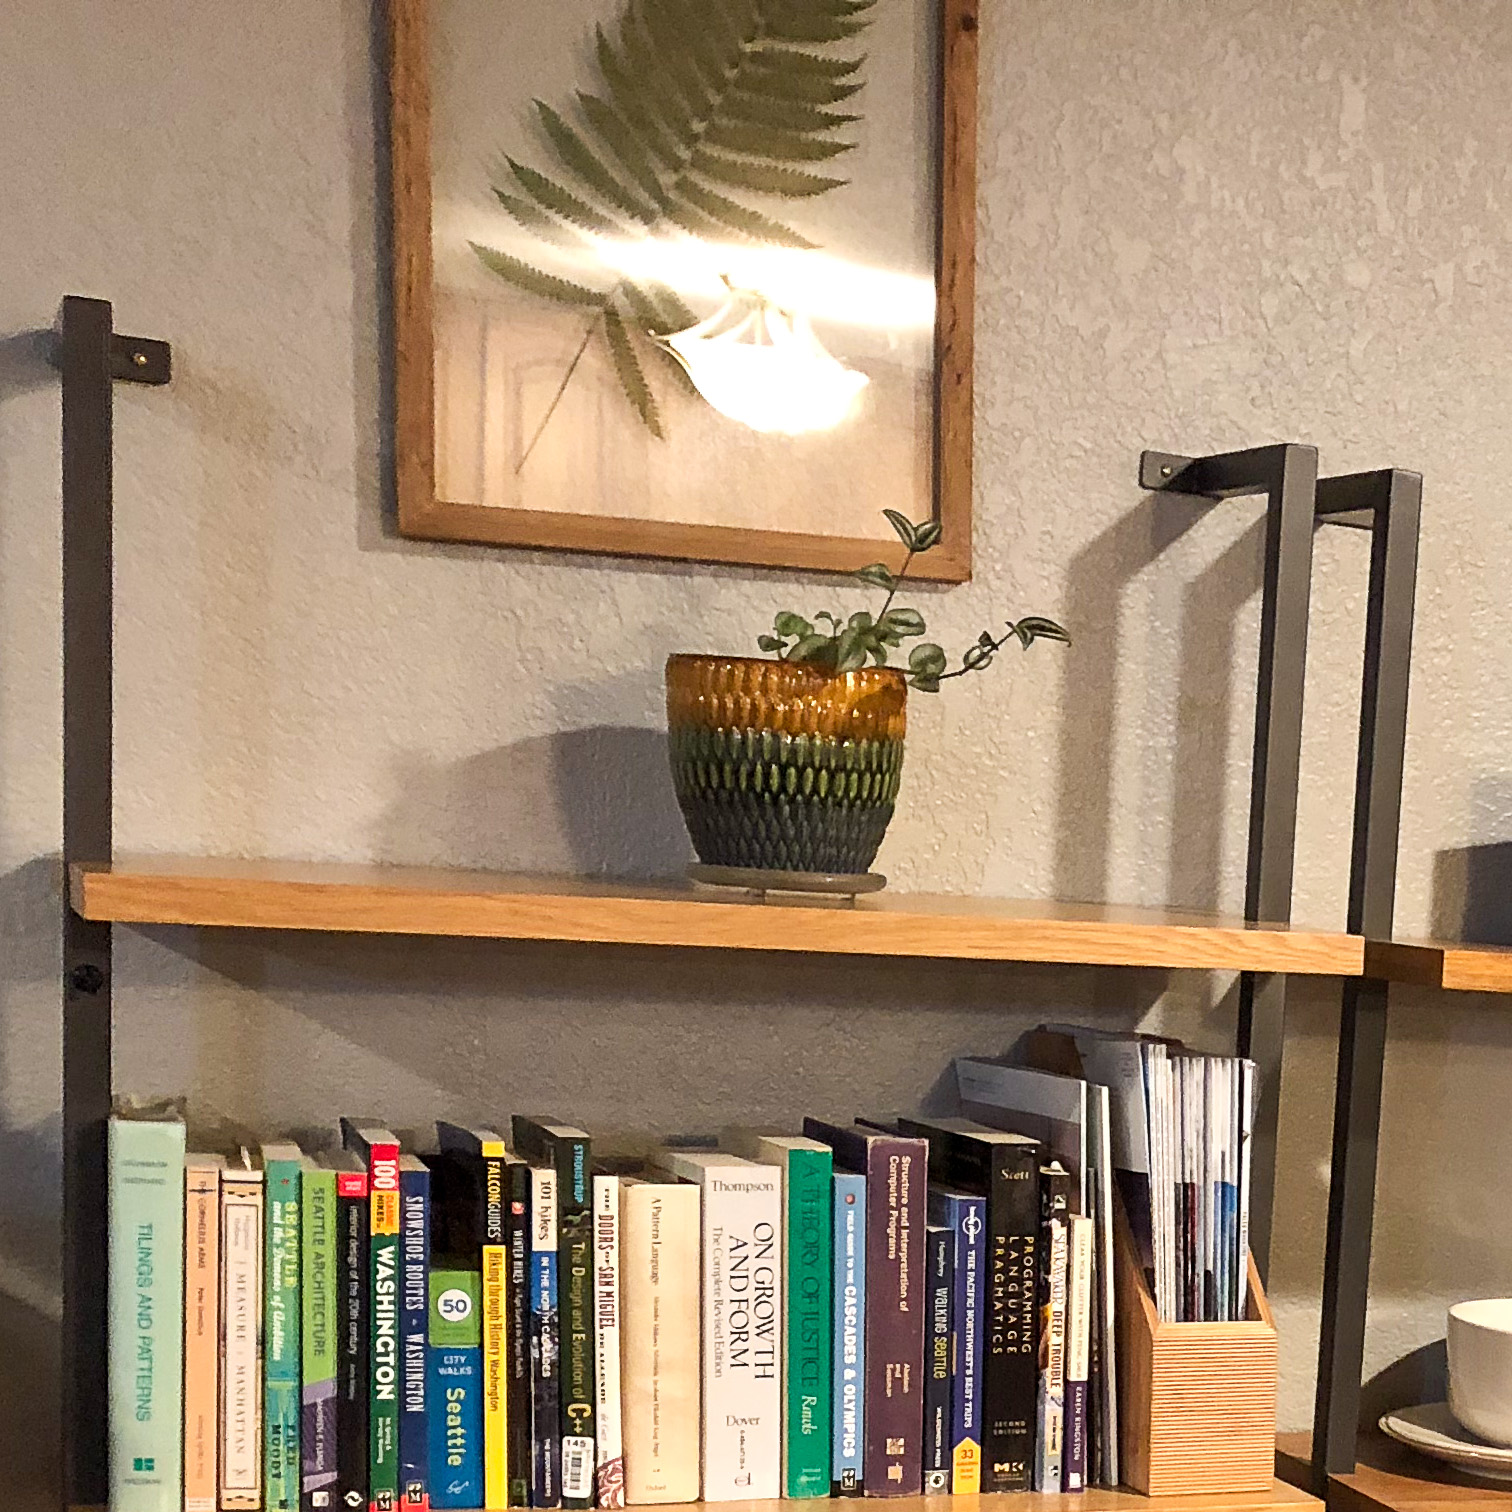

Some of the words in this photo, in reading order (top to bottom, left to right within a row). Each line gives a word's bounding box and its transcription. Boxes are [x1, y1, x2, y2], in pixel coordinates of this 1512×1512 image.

[374, 1159, 395, 1188] 100
[573, 1144, 583, 1203] STROUSTRUP
[712, 1181, 774, 1191] Thompson
[801, 1166, 819, 1178] A
[887, 1155, 898, 1206] Computer
[899, 1155, 910, 1204] Structure
[1001, 1170, 1028, 1179] Scott
[487, 1161, 501, 1238] FALCONGUIDES
[540, 1180, 552, 1200] 101
[272, 1201, 283, 1227] and
[312, 1187, 325, 1246] SEATTLE
[375, 1195, 384, 1221] HIKES
[539, 1206, 552, 1240] hikes
[652, 1206, 661, 1239] Pattern
[900, 1207, 909, 1227] and
[272, 1229, 283, 1246] the
[284, 1201, 297, 1287] SEATTLE
[405, 1196, 424, 1260] SNOWSHOE
[512, 1230, 524, 1258] WINTER
[598, 1214, 615, 1251] DOORS
[713, 1226, 723, 1246] The
[754, 1222, 774, 1260] ON
[800, 1185, 819, 1268] THEORY
[887, 1210, 898, 1259] Programs
[137, 1224, 153, 1288] TILINGS
[348, 1239, 358, 1268] design
[488, 1252, 501, 1281] Hiking
[540, 1257, 549, 1266] IN
[572, 1242, 586, 1263] The
[650, 1241, 661, 1286] Language
[729, 1235, 749, 1293] AND
[847, 1257, 854, 1268] TO
[898, 1229, 910, 1298] Interpretation
[936, 1240, 946, 1277] Humphrey
[966, 1250, 975, 1269] THE
[349, 1270, 359, 1280] of
[349, 1282, 359, 1296] the
[406, 1265, 424, 1310] ROUTES
[512, 1261, 523, 1284] HIKES
[540, 1269, 549, 1287] THE
[571, 1267, 585, 1306] Design
[599, 1266, 615, 1287] SAN
[711, 1248, 723, 1297] Complete
[846, 1269, 854, 1284] THE
[965, 1271, 975, 1307] PACIFIC
[236, 1273, 246, 1342] MEASURE
[270, 1295, 283, 1308] of
[311, 1252, 325, 1357] ARCHITECTURE
[349, 1299, 359, 1319] 20th
[443, 1298, 467, 1313] 50
[487, 1283, 501, 1320] through
[599, 1290, 615, 1328] MIGUEL
[801, 1277, 819, 1306] OF
[900, 1300, 909, 1312] of
[992, 1236, 1005, 1354] PRAGMATICS
[1007, 1236, 1018, 1354] LANGUAGE
[1021, 1236, 1034, 1354] PROGRAMMING
[137, 1297, 153, 1330] AND
[376, 1245, 394, 1400] WASHINGTON
[572, 1310, 585, 1330] and
[713, 1299, 724, 1339] Revised
[753, 1266, 775, 1380] GROWTH
[844, 1286, 856, 1363] CASCADES
[1052, 1311, 1063, 1337] DEEP
[348, 1321, 358, 1355] century
[487, 1323, 501, 1356] History
[540, 1325, 551, 1378] CASCADES
[729, 1299, 749, 1369] FORM
[801, 1308, 820, 1387] JUSTICE
[406, 1334, 424, 1412] WASHINGTON
[438, 1367, 472, 1375] WALKS
[443, 1356, 467, 1364] CITY
[572, 1333, 585, 1383] Evolution
[714, 1341, 724, 1378] Edition
[844, 1369, 856, 1380] &
[1050, 1343, 1062, 1388] TROUBLE
[135, 1335, 153, 1422] PATTERNS
[489, 1359, 500, 1412] Washington
[573, 1385, 586, 1399] of
[964, 1377, 974, 1398] BEST
[235, 1365, 246, 1454] MANHATTAN
[446, 1388, 465, 1466] Seattle
[568, 1403, 591, 1433] C++
[726, 1415, 760, 1426] Dover
[801, 1395, 818, 1435] Rawls
[843, 1384, 855, 1457] OLYMPICS
[964, 1399, 973, 1428] TRIPS
[994, 1420, 1027, 1428] SECOND
[286, 1424, 296, 1466] FRED
[566, 1439, 587, 1448] 145
[993, 1427, 1027, 1435] EDITION
[1074, 1417, 1082, 1460] KINGSTON
[271, 1424, 282, 1480] MOODY
[961, 1450, 974, 1458] 33
